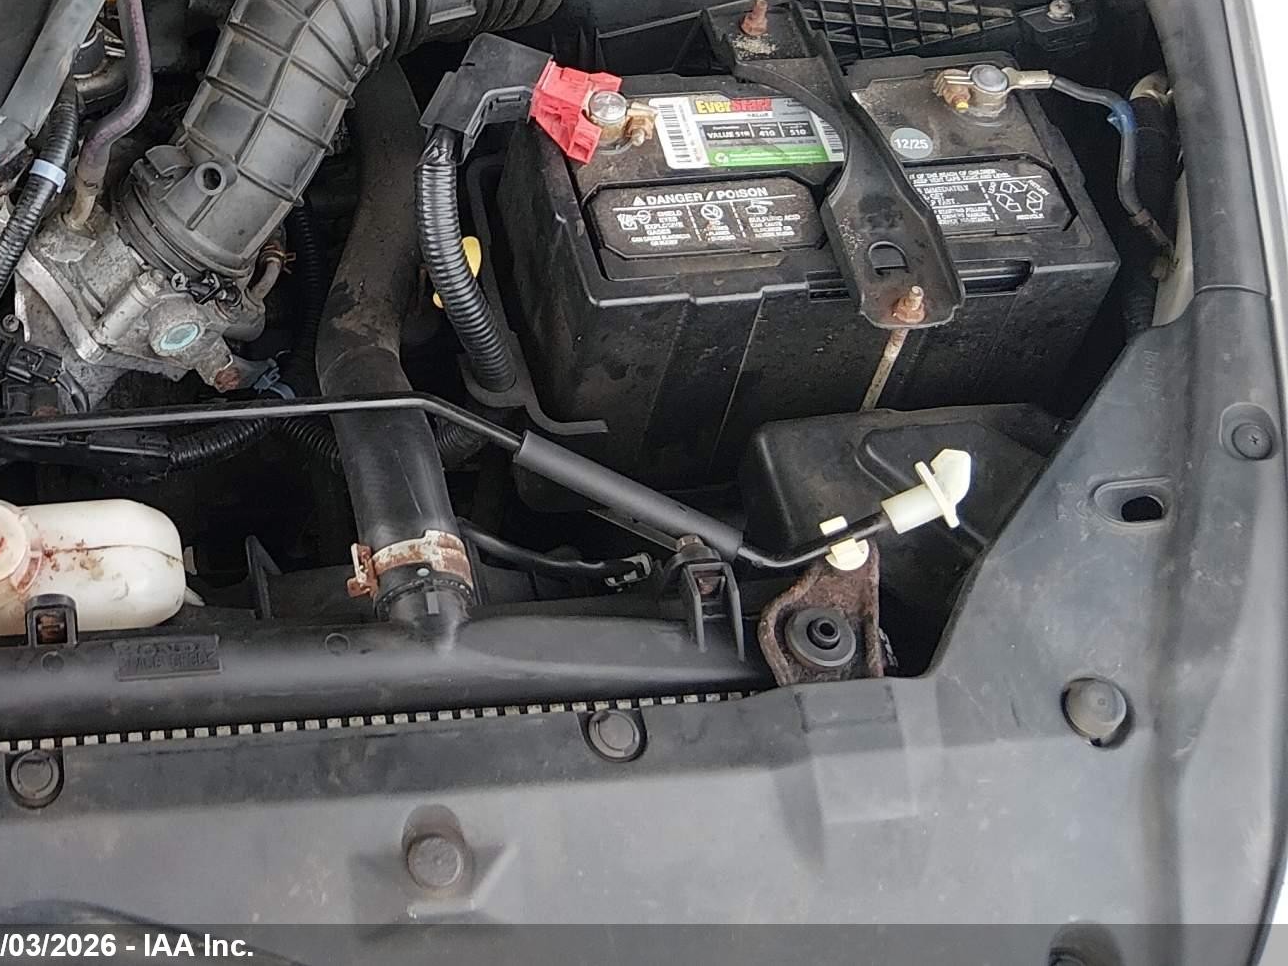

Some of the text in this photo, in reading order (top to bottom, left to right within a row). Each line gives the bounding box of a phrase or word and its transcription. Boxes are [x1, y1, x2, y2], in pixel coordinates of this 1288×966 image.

[893, 138, 929, 149] 12/25
[646, 192, 704, 206] DANGER
[716, 187, 769, 200] POISON
